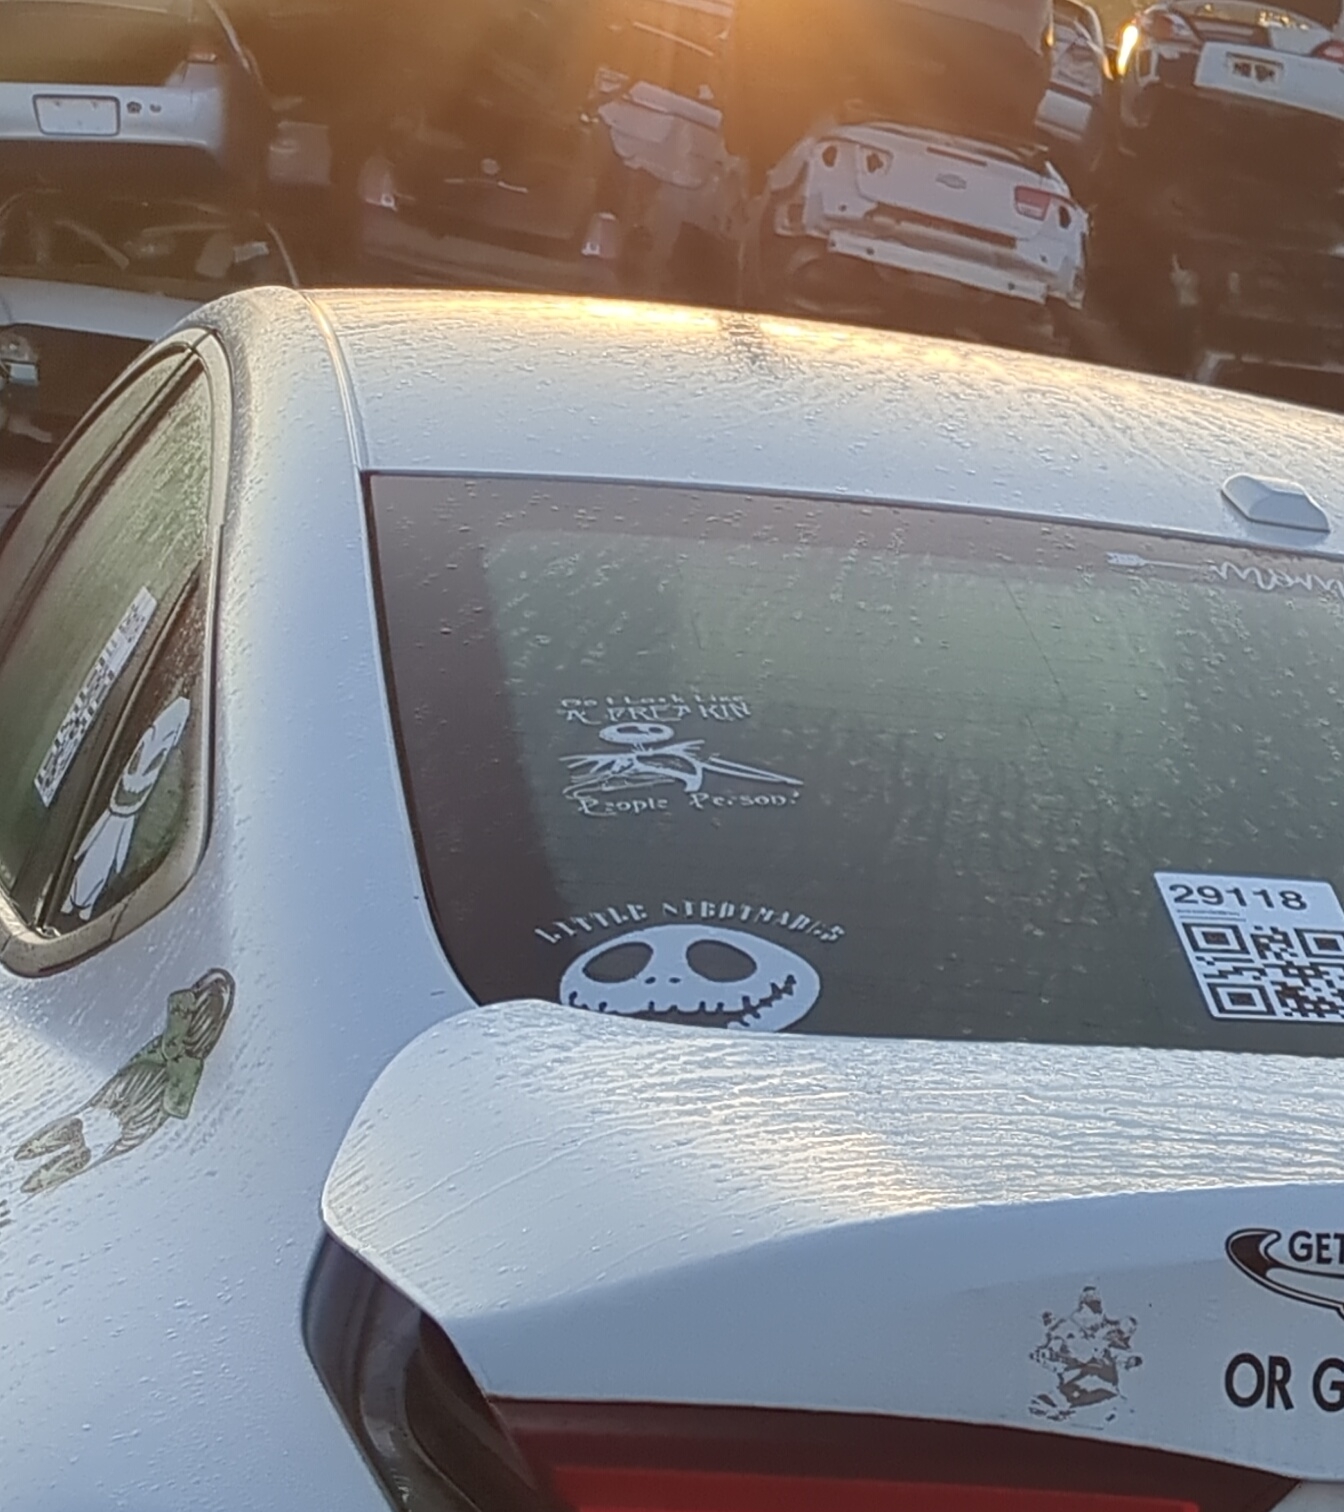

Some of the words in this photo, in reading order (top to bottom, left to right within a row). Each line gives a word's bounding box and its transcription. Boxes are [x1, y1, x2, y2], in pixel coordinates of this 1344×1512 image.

[1168, 883, 1308, 912] 29118
[534, 903, 648, 944] LITTLE
[1223, 1352, 1295, 1412] OR
